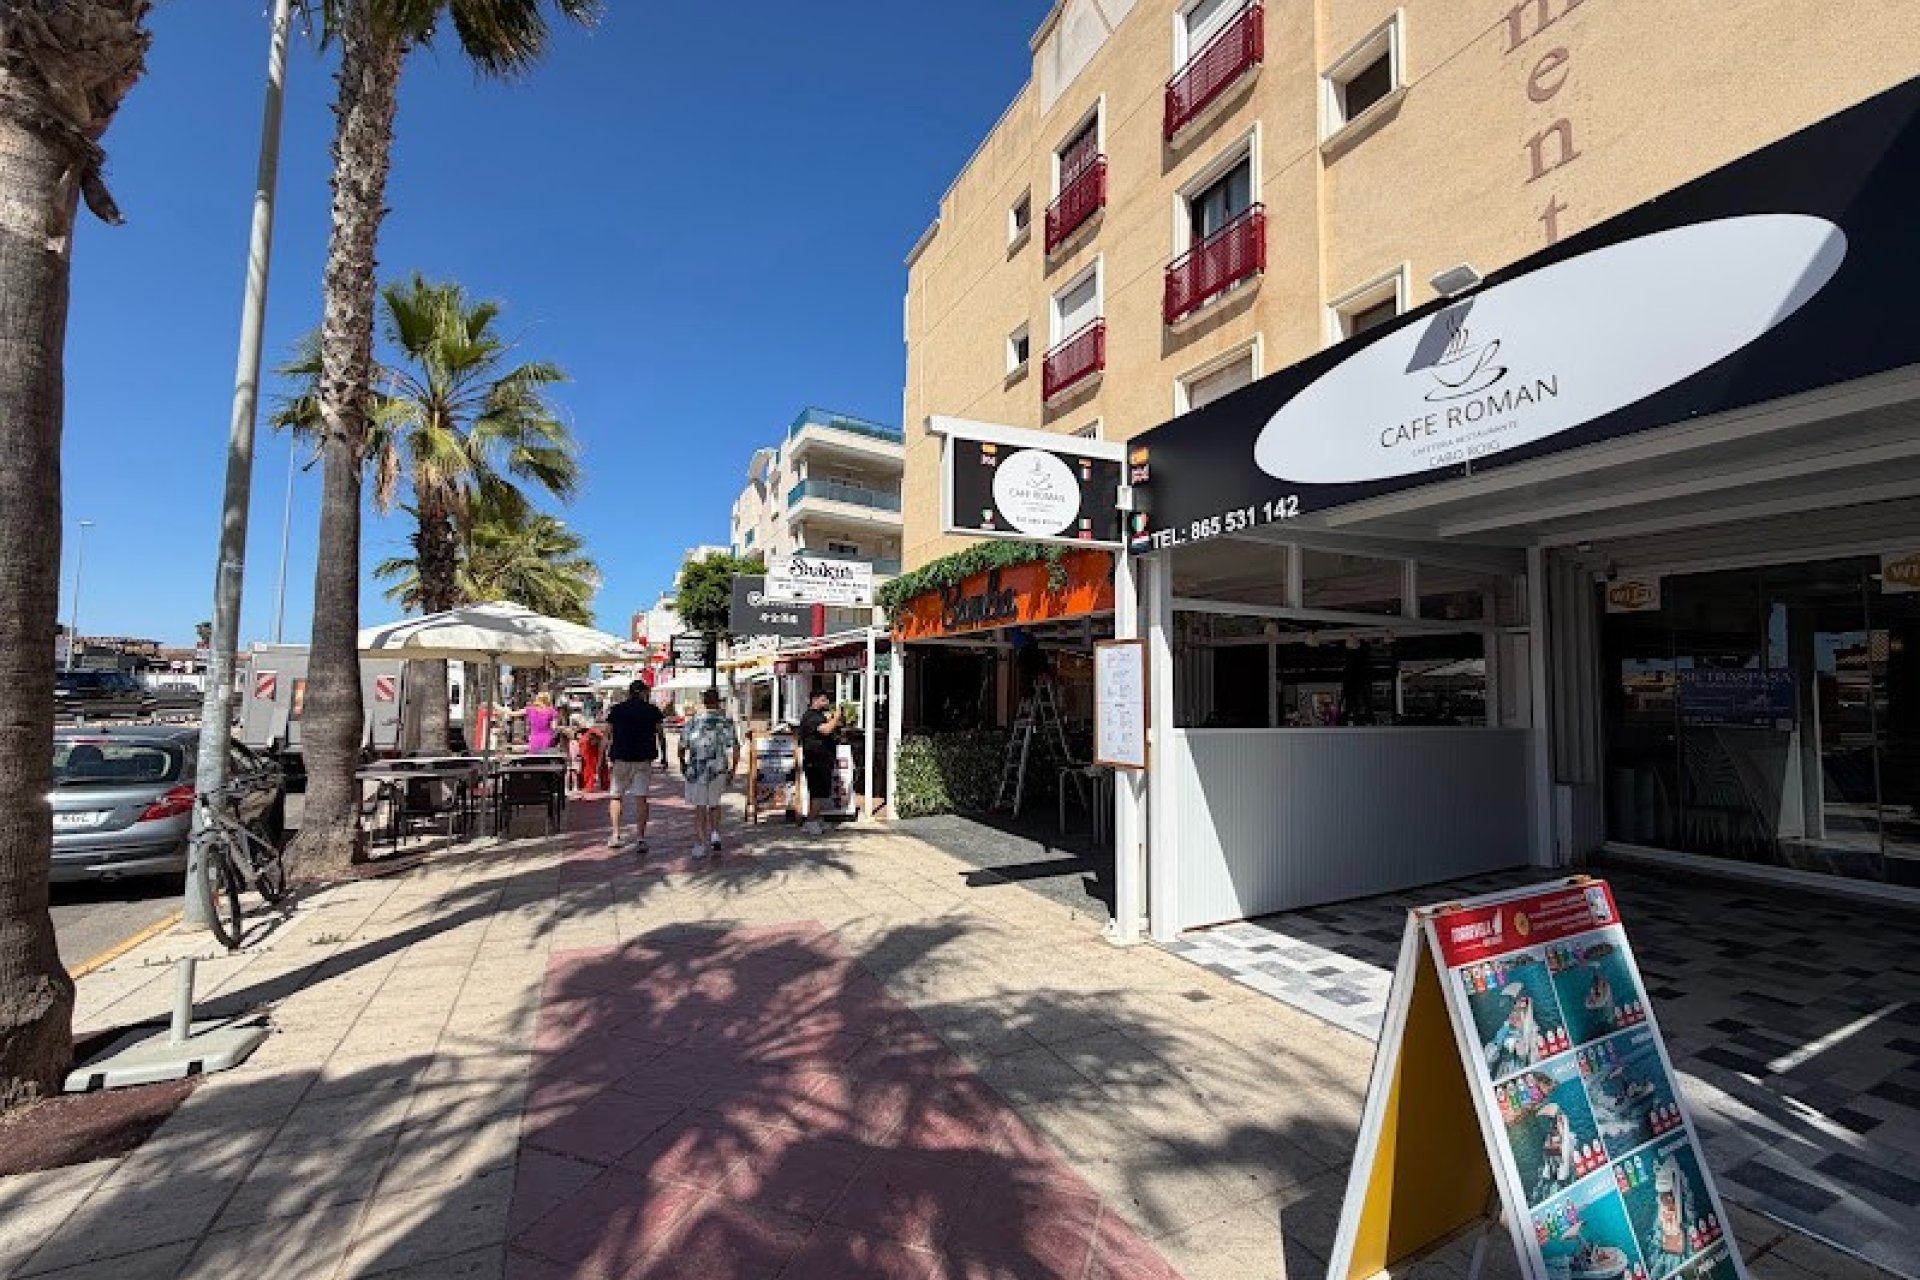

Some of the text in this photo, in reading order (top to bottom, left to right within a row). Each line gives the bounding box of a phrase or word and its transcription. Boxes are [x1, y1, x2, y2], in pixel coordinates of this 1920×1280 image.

[1380, 374, 1559, 448] CAFE ROMAN
[1150, 494, 1300, 550] TEL: 865 531 142
